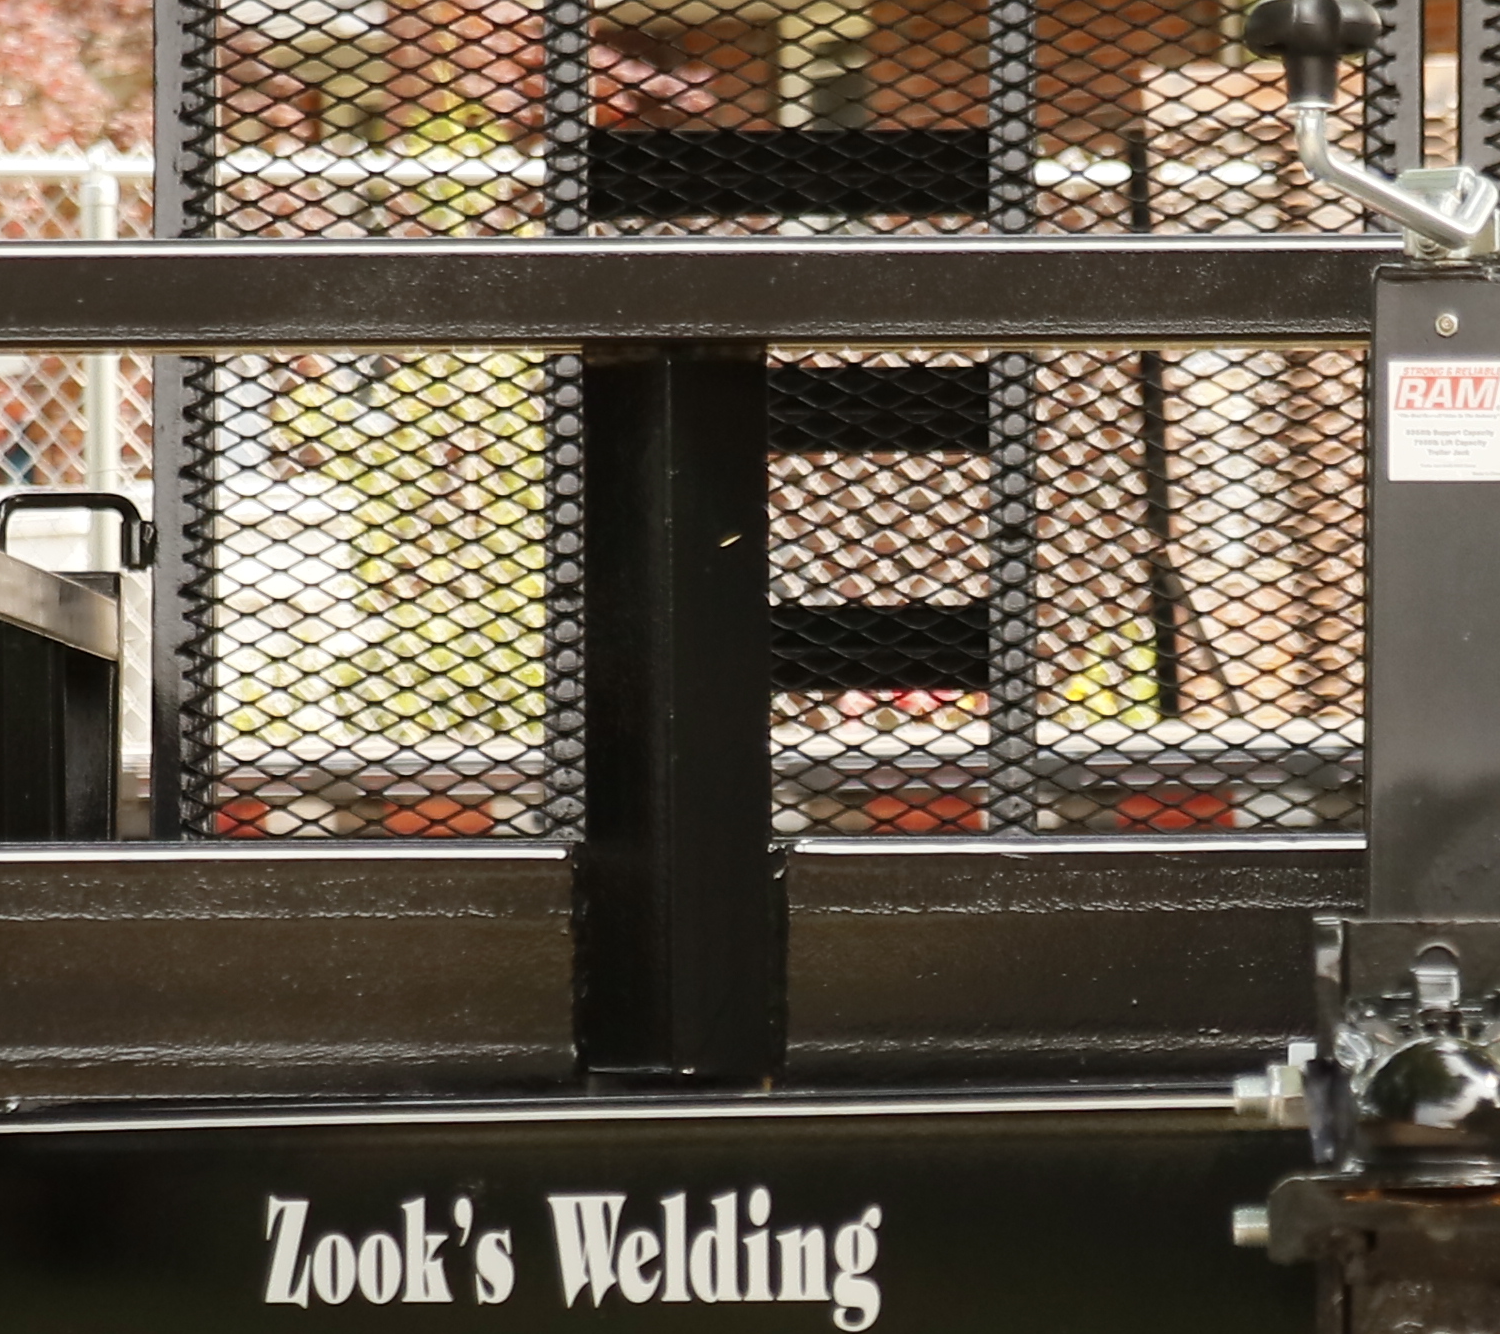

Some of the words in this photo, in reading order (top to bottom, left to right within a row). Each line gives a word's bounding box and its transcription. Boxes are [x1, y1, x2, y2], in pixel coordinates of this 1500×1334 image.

[1403, 366, 1444, 376] STRONG
[1397, 378, 1497, 409] RAM
[264, 1194, 515, 1309] Zook's
[548, 1187, 882, 1333] Welding
